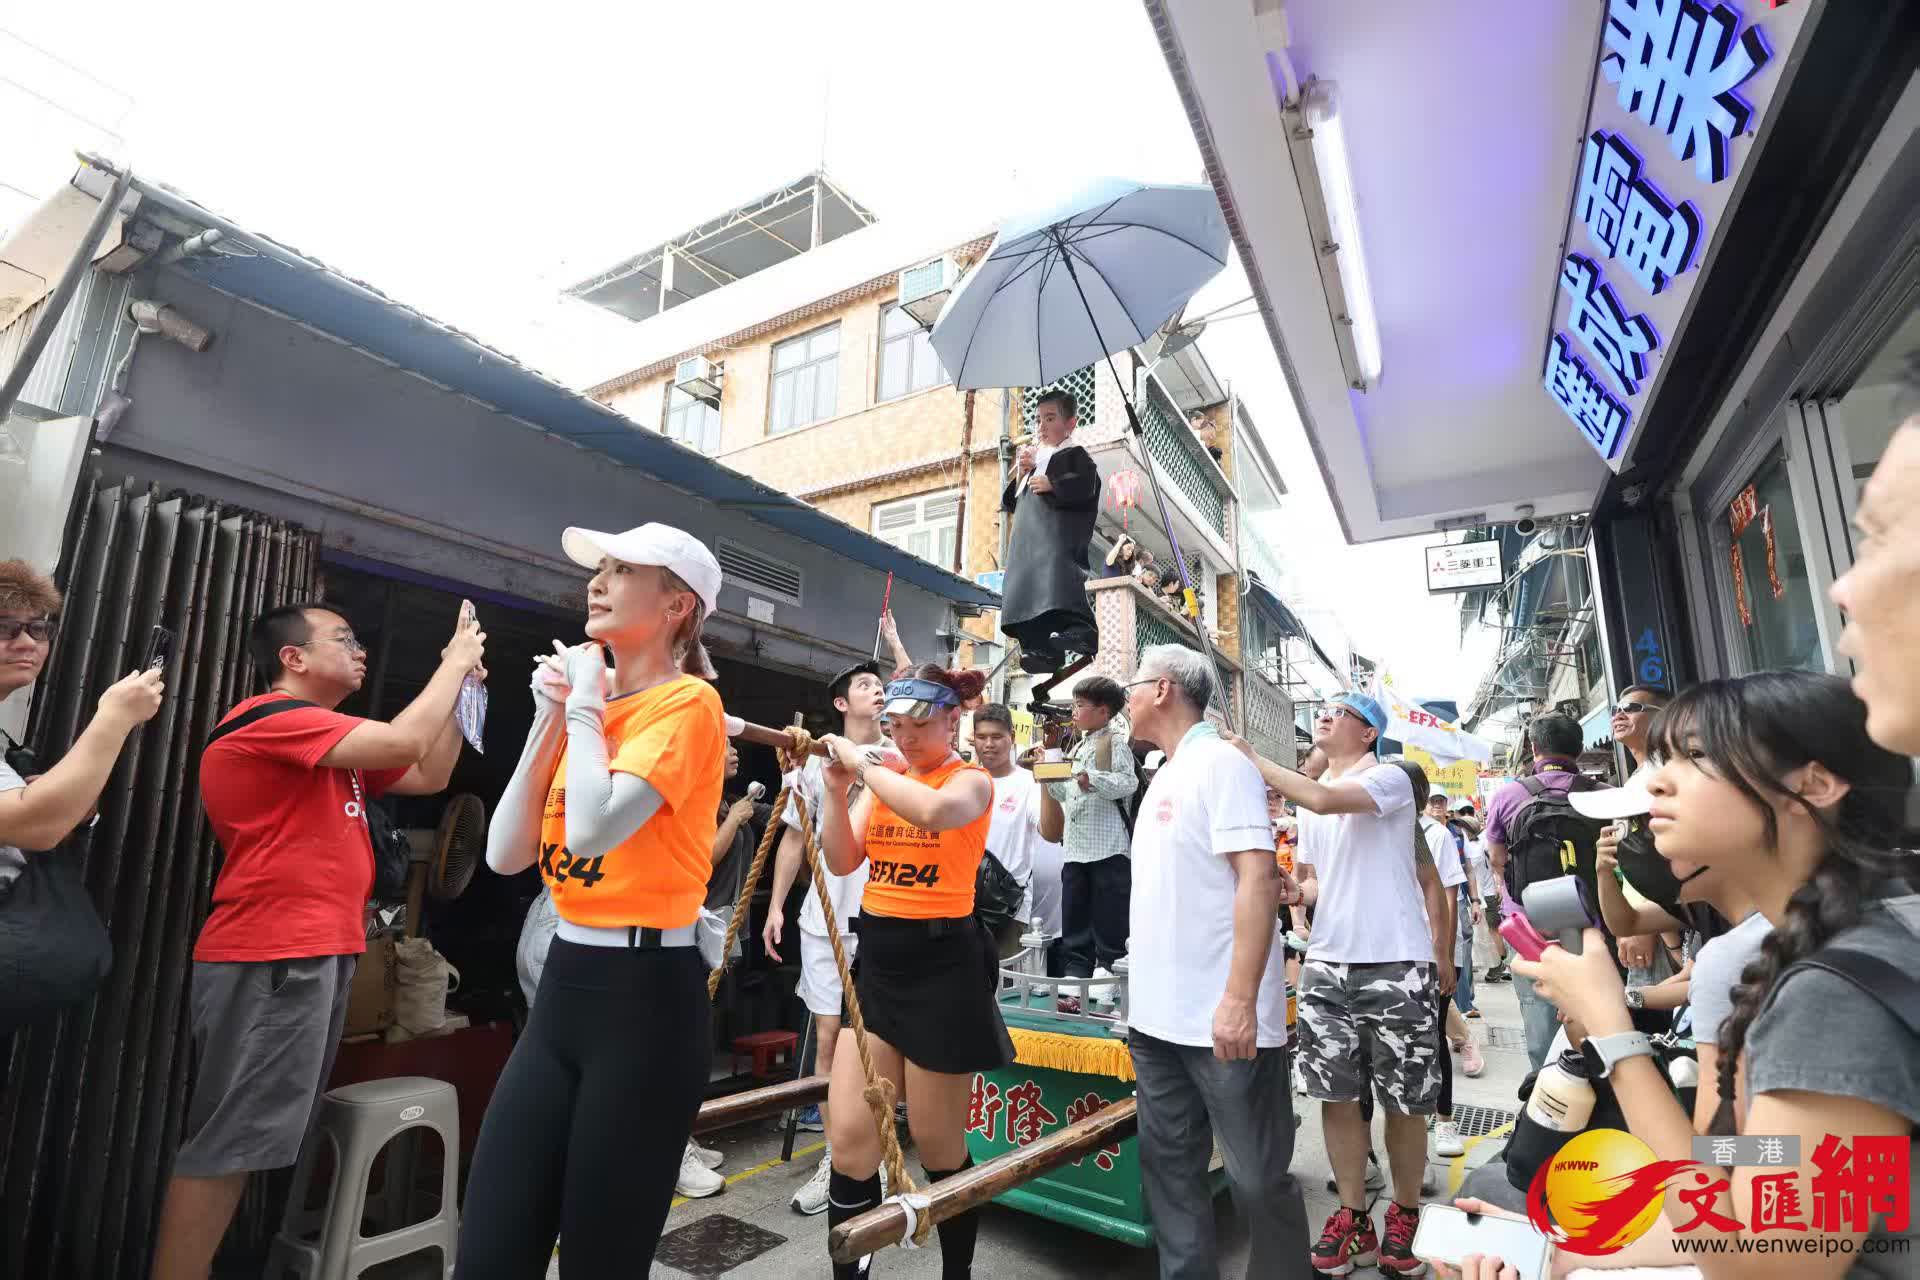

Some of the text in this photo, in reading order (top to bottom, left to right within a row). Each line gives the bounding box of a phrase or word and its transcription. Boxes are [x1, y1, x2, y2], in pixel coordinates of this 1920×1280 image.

[1447, 556, 1497, 571] 三菱重工
[1407, 710, 1440, 729] EFX
